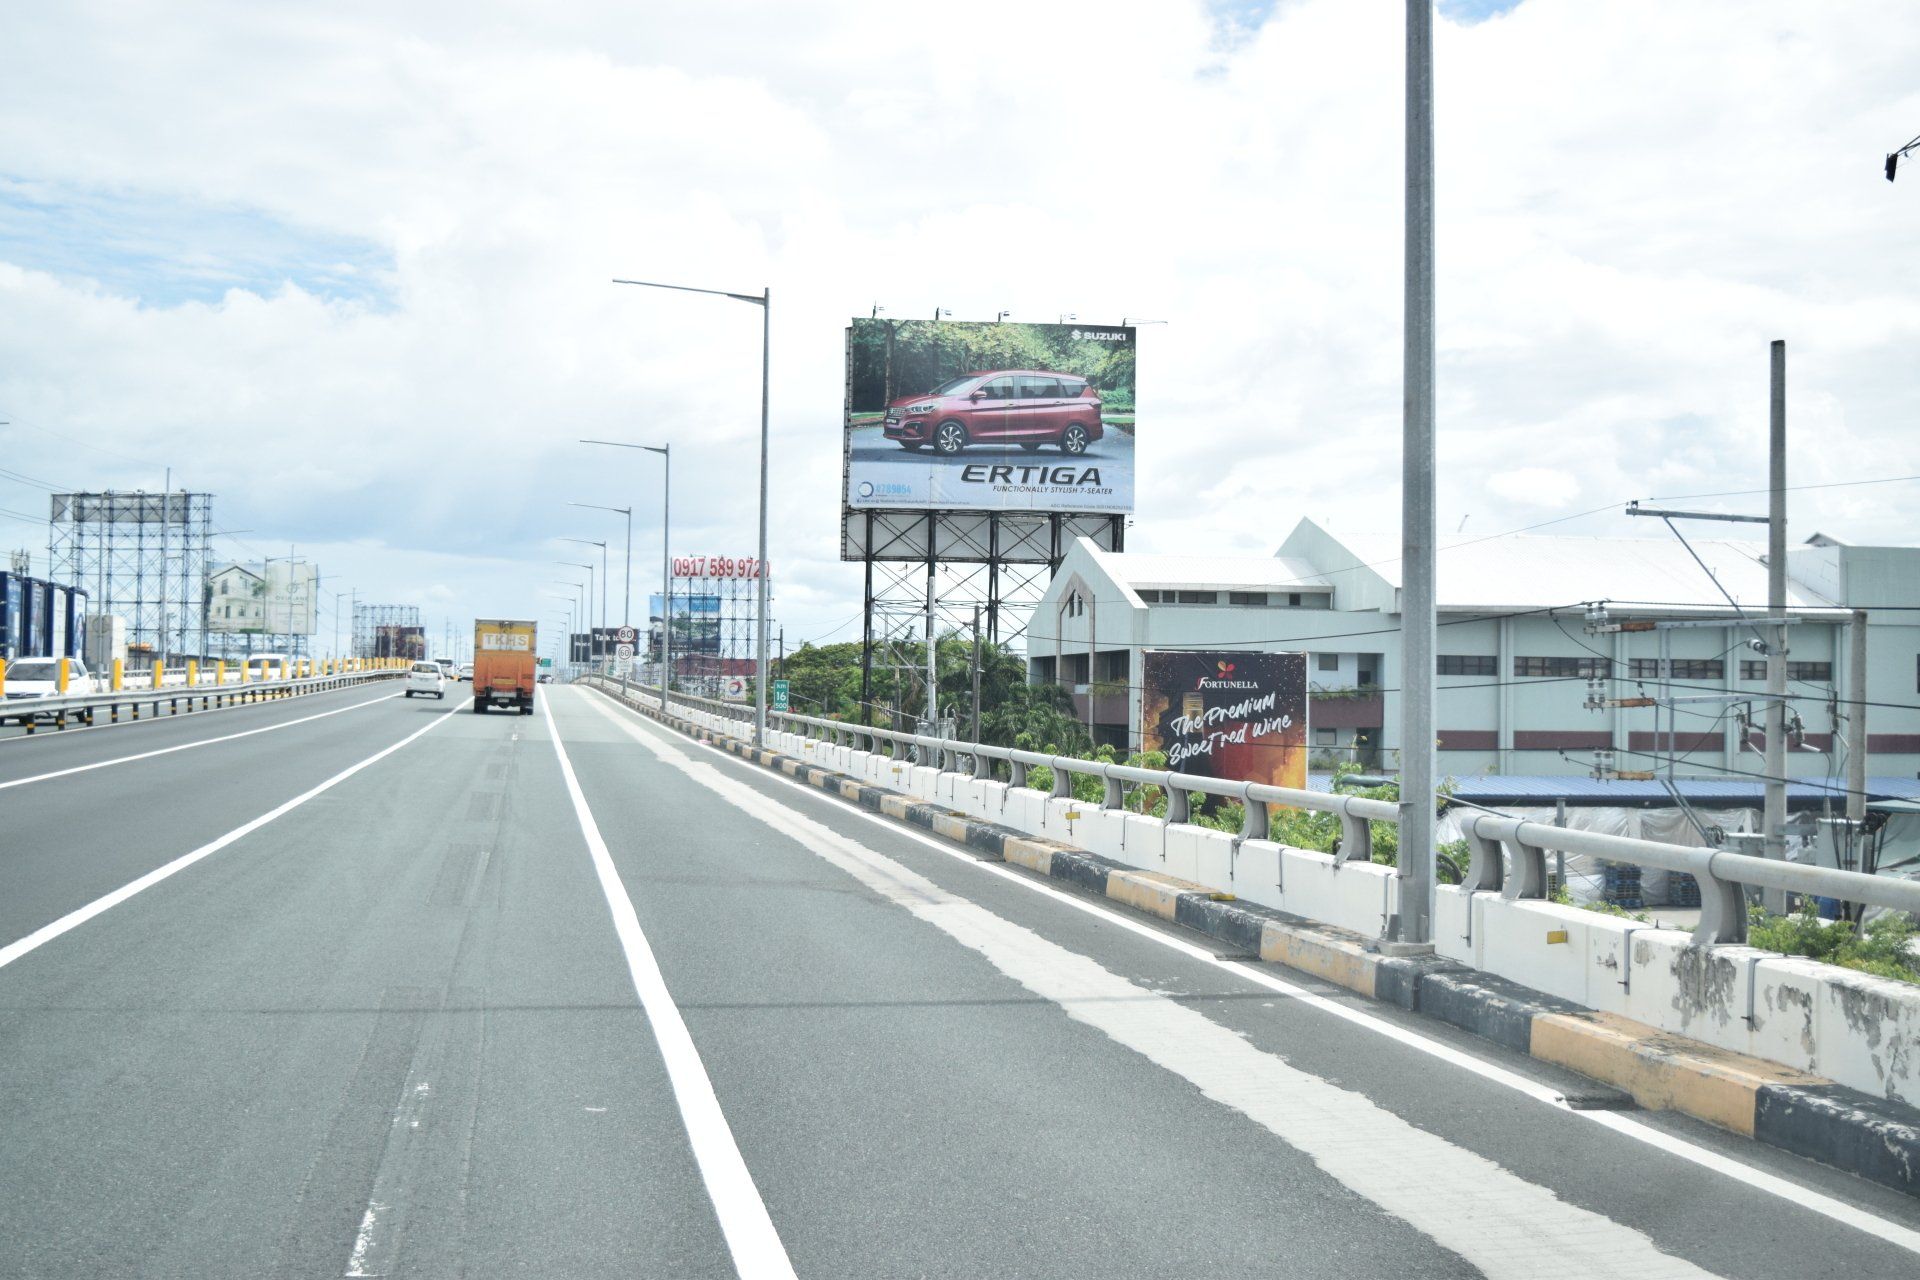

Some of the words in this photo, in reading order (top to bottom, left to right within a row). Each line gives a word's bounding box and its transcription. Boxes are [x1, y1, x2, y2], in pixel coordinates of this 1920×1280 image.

[1083, 331, 1127, 341] SUZUKI
[961, 464, 1102, 486] ERTIGA
[992, 485, 1049, 494] FUNCTIONALLY
[1050, 486, 1078, 495] STYLISH
[1079, 487, 1113, 496] 7-SEATER
[673, 558, 706, 577] 0917
[709, 558, 734, 577] 589
[620, 629, 633, 639] 80
[620, 649, 630, 657] 60
[1195, 676, 1259, 690] FORTUNELLA
[776, 691, 787, 701] 16
[1170, 714, 1204, 737] The
[1203, 691, 1276, 726] Premium
